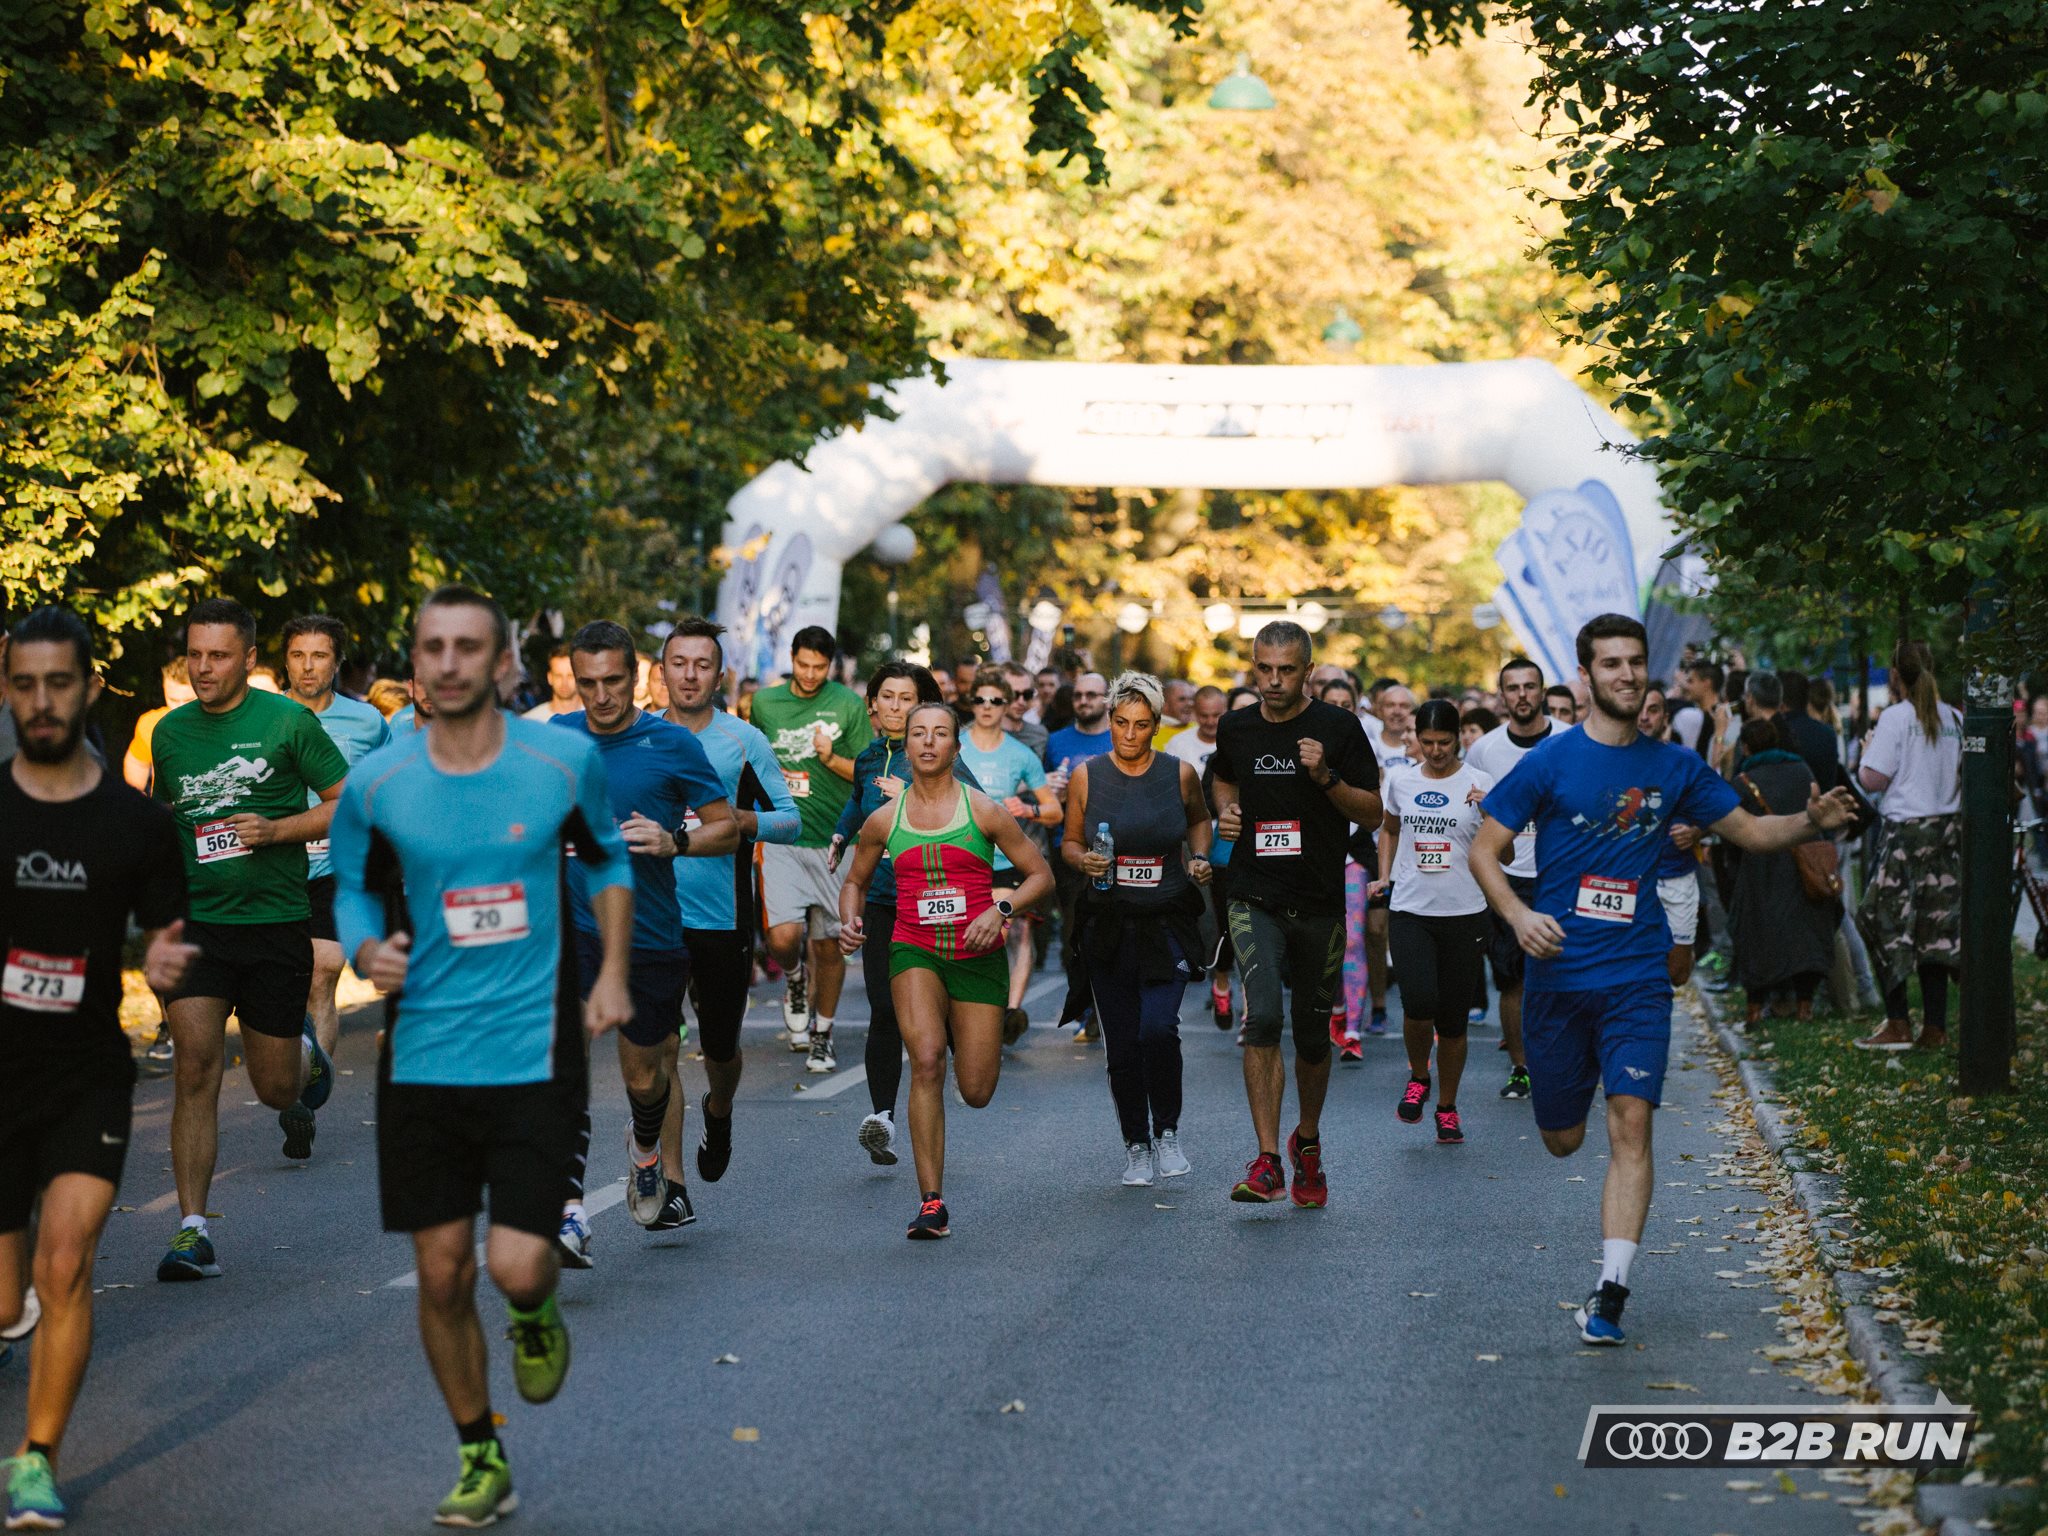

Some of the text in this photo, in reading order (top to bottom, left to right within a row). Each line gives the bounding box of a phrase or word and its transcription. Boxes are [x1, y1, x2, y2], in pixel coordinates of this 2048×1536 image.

[1254, 754, 1296, 770] ZONA
[1419, 793, 1445, 805] R&S
[1403, 815, 1458, 828] RUNNING
[1413, 825, 1446, 835] TEAM
[206, 832, 239, 852] 562
[1264, 833, 1290, 847] 275
[16, 850, 88, 881] ZONA
[1420, 853, 1442, 864] 223
[1127, 868, 1153, 879] 120
[927, 899, 955, 915] 265
[1591, 892, 1623, 911] 443
[472, 909, 501, 930] 20
[21, 973, 64, 998] 273
